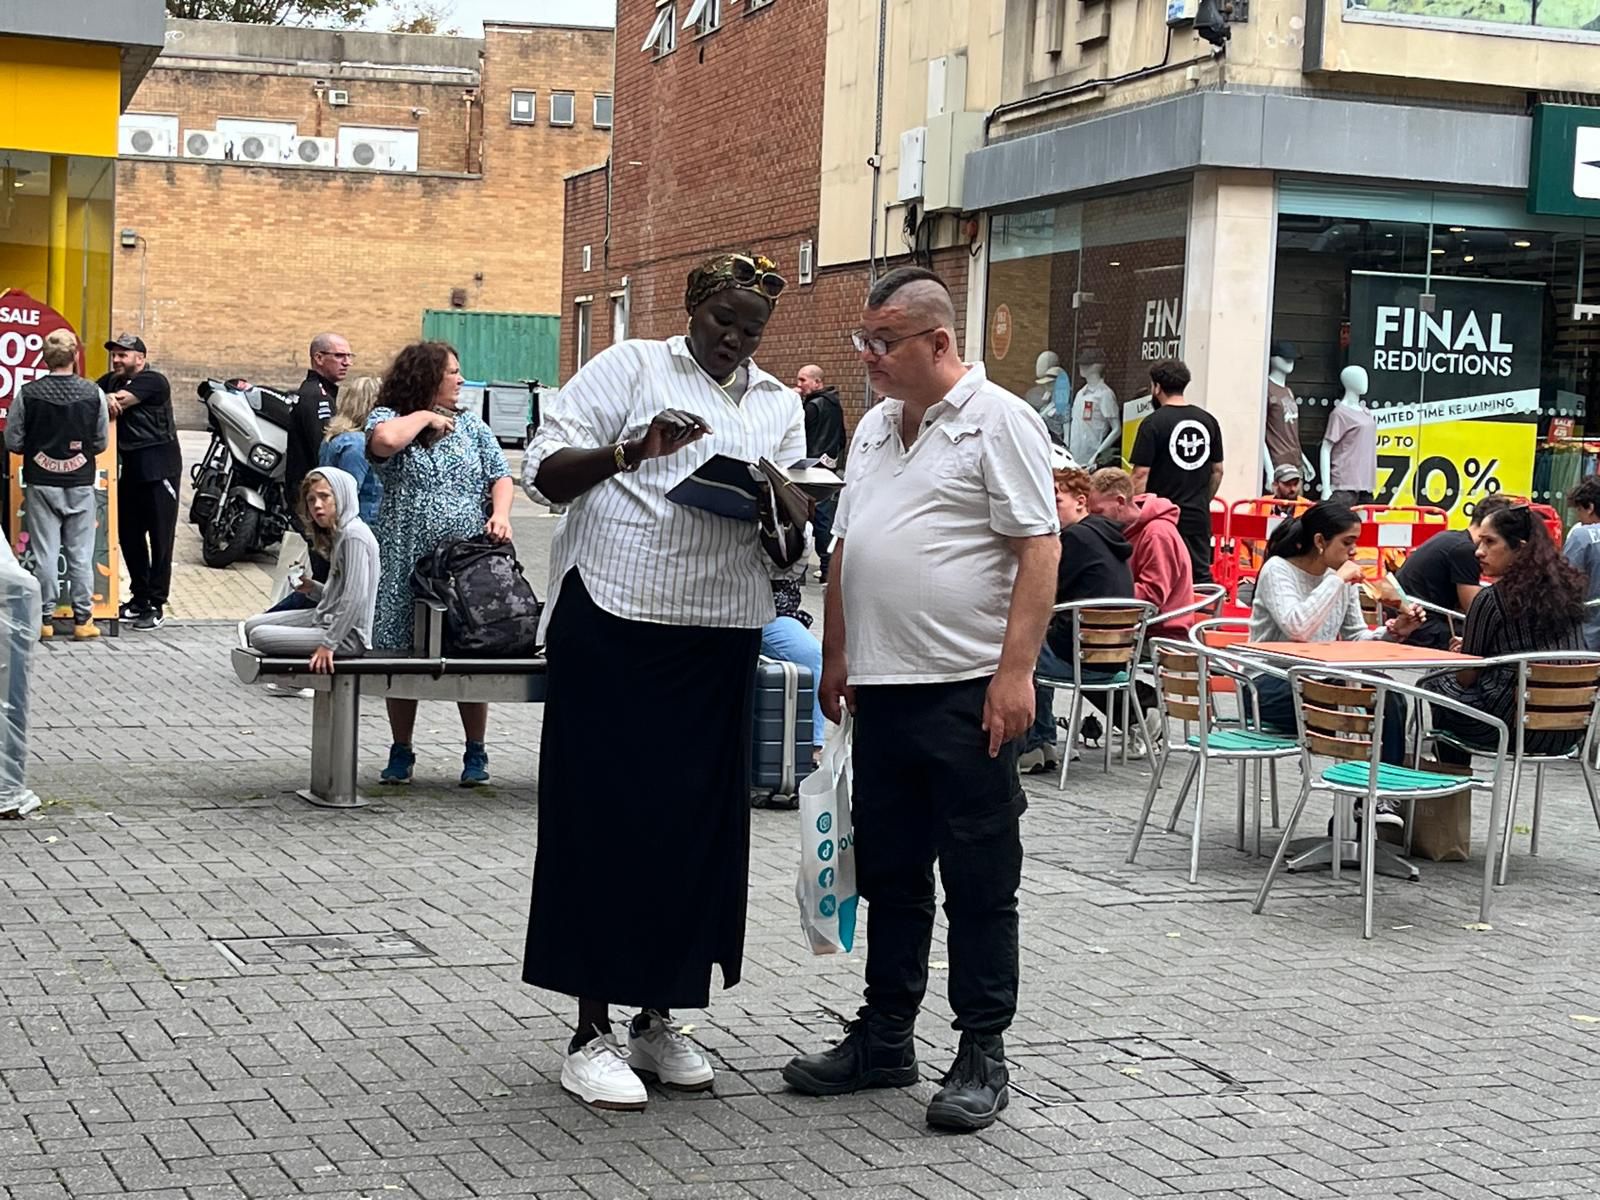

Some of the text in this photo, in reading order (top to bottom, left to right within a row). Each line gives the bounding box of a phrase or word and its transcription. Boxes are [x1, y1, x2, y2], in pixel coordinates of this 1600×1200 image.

[0, 307, 40, 326] SALE
[1375, 306, 1513, 353] FINAL
[1374, 350, 1512, 377] REDUCTIONS
[1373, 410, 1414, 425] IMITED
[1418, 408, 1444, 418] TIME
[1395, 436, 1413, 447] TO
[36, 452, 87, 472] ENGLAND
[1375, 455, 1500, 514] 70%
